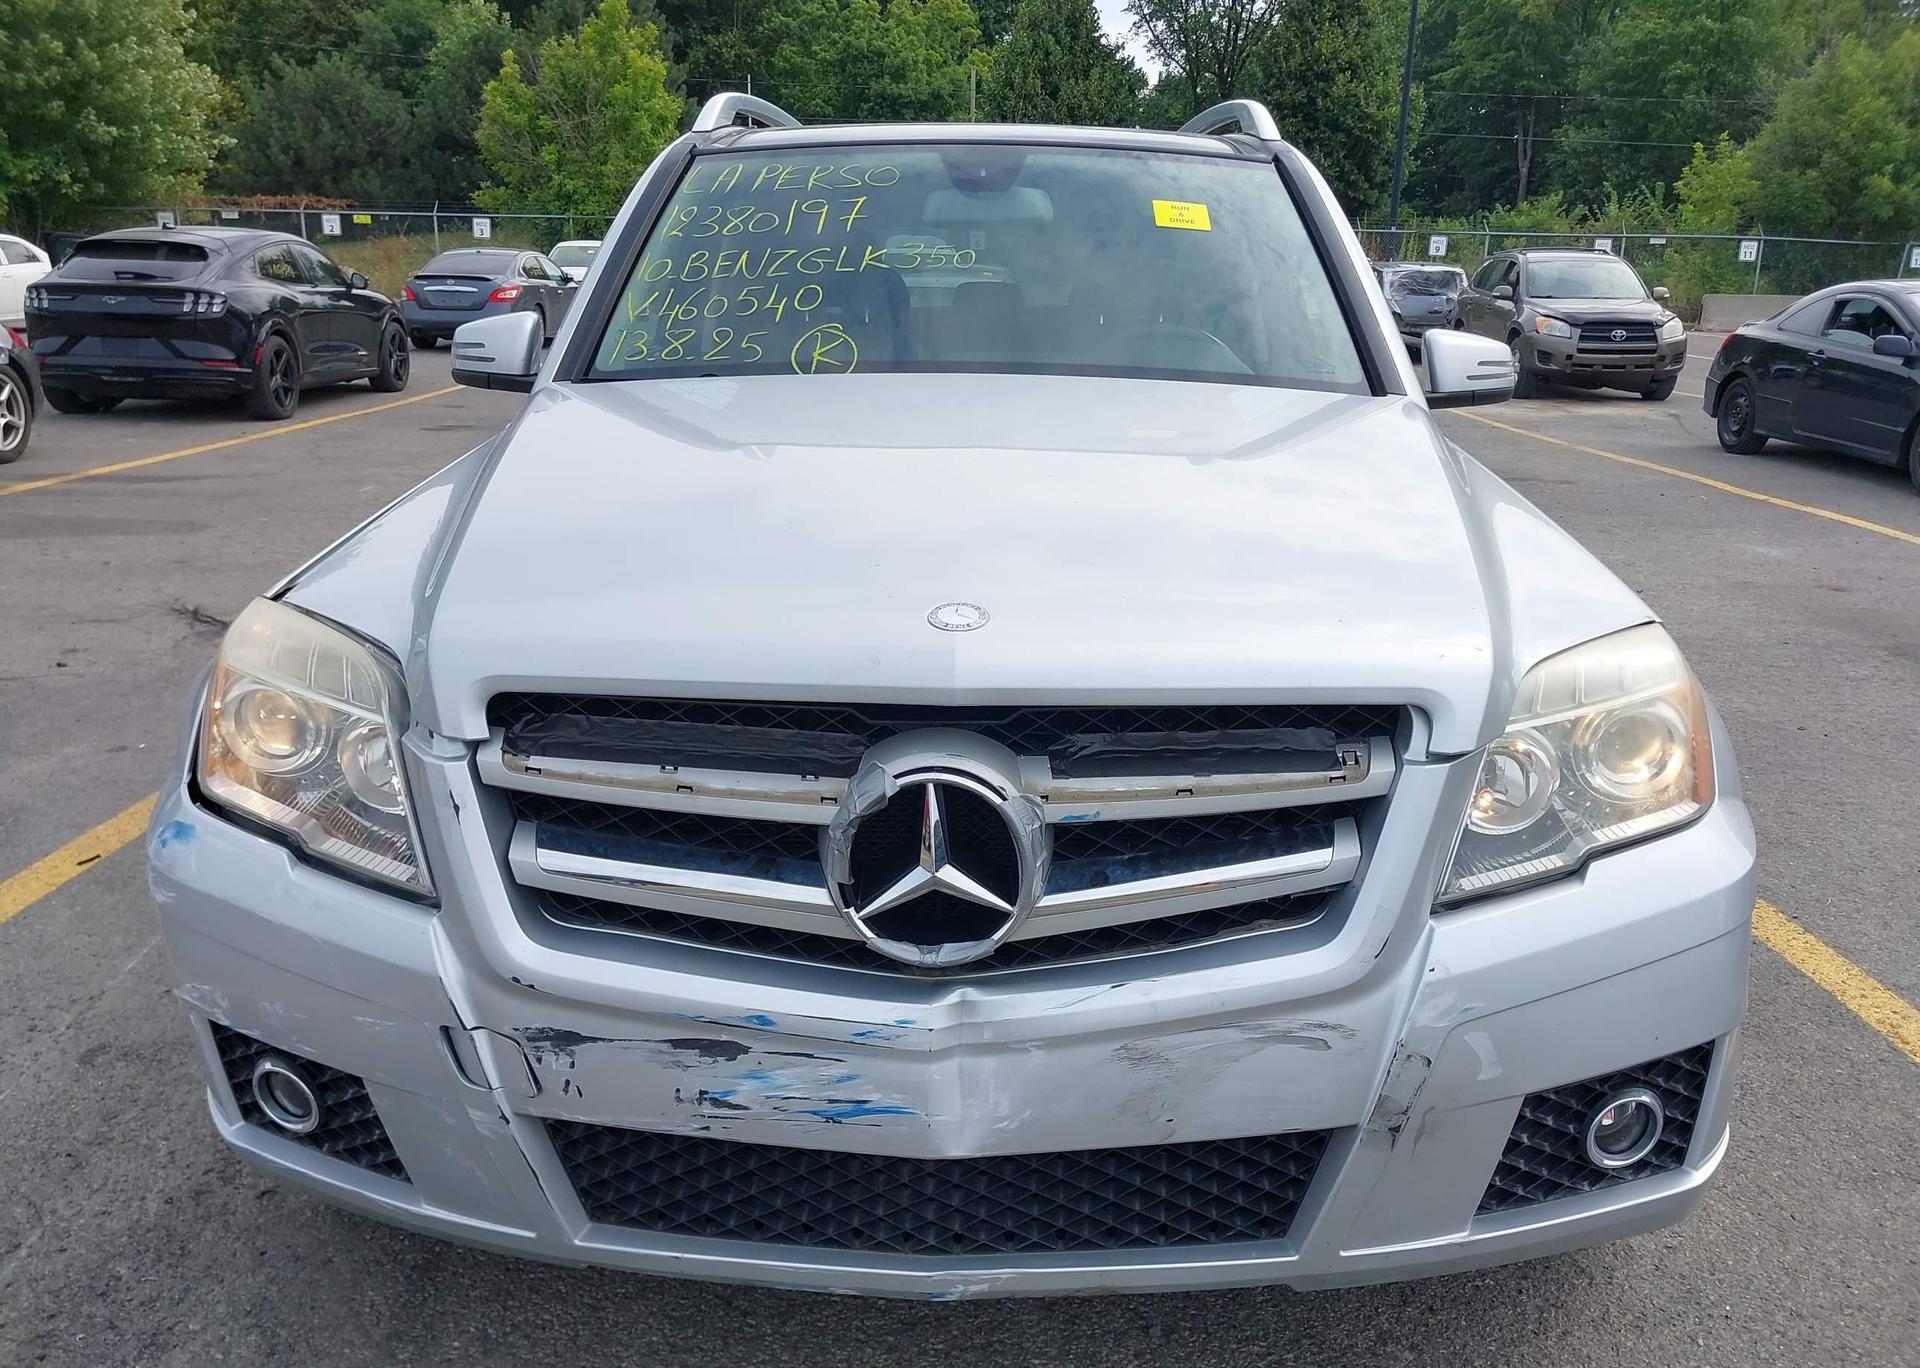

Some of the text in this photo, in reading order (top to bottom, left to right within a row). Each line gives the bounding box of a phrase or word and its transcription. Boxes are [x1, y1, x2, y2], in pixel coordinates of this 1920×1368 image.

[684, 163, 901, 194] LA PERSO
[660, 195, 869, 242] 12380197
[1169, 217, 1197, 225] DRIVE
[329, 224, 335, 232] 2
[479, 228, 484, 236] 3
[1435, 245, 1441, 253] 9
